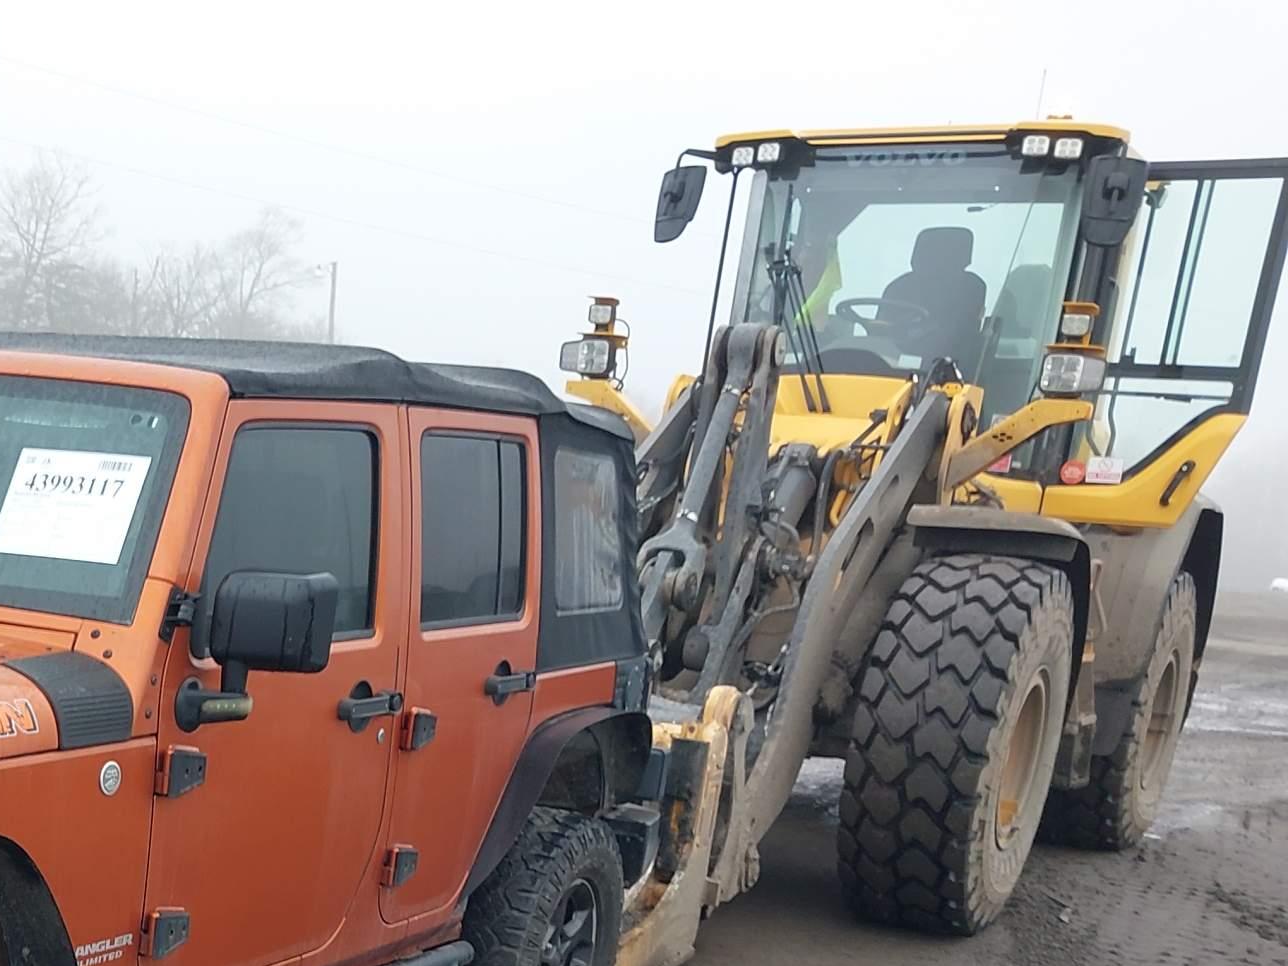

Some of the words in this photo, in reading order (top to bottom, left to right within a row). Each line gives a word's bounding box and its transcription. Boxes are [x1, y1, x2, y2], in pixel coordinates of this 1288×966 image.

[845, 151, 967, 168] VOLVO
[24, 473, 125, 497] 43993117
[75, 933, 133, 958] ANGLER
